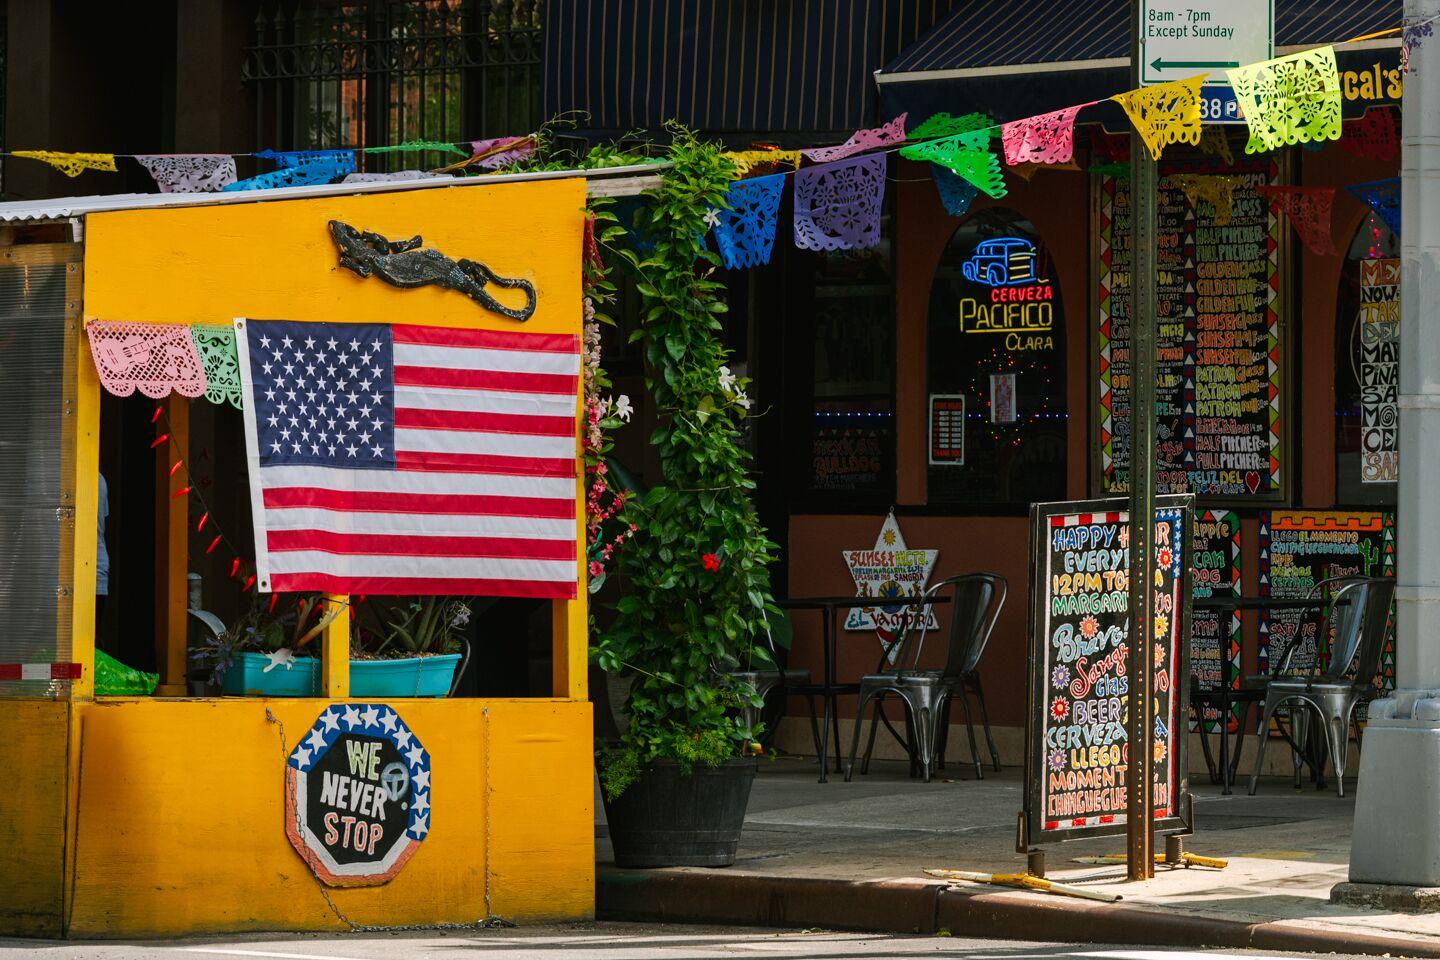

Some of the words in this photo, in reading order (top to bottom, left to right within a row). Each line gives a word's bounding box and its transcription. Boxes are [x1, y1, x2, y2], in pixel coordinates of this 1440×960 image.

[1149, 9, 1174, 21] 8am
[1186, 9, 1211, 23] 7pm
[1148, 25, 1187, 40] Except
[1192, 25, 1234, 40] Sunday
[1340, 63, 1403, 101] cal's
[991, 286, 1053, 303] CERVEZA
[960, 298, 1053, 332] PACIFICO
[1005, 333, 1053, 351] CLARA
[1052, 525, 1117, 552] HAPPY
[1052, 590, 1131, 617] MARGARI
[1073, 697, 1121, 724] BEER
[346, 740, 382, 781] WE
[1071, 744, 1121, 770] LLEGO
[1049, 765, 1128, 794] MOMENT
[320, 771, 387, 821] NEVER
[324, 812, 383, 855] STOP
